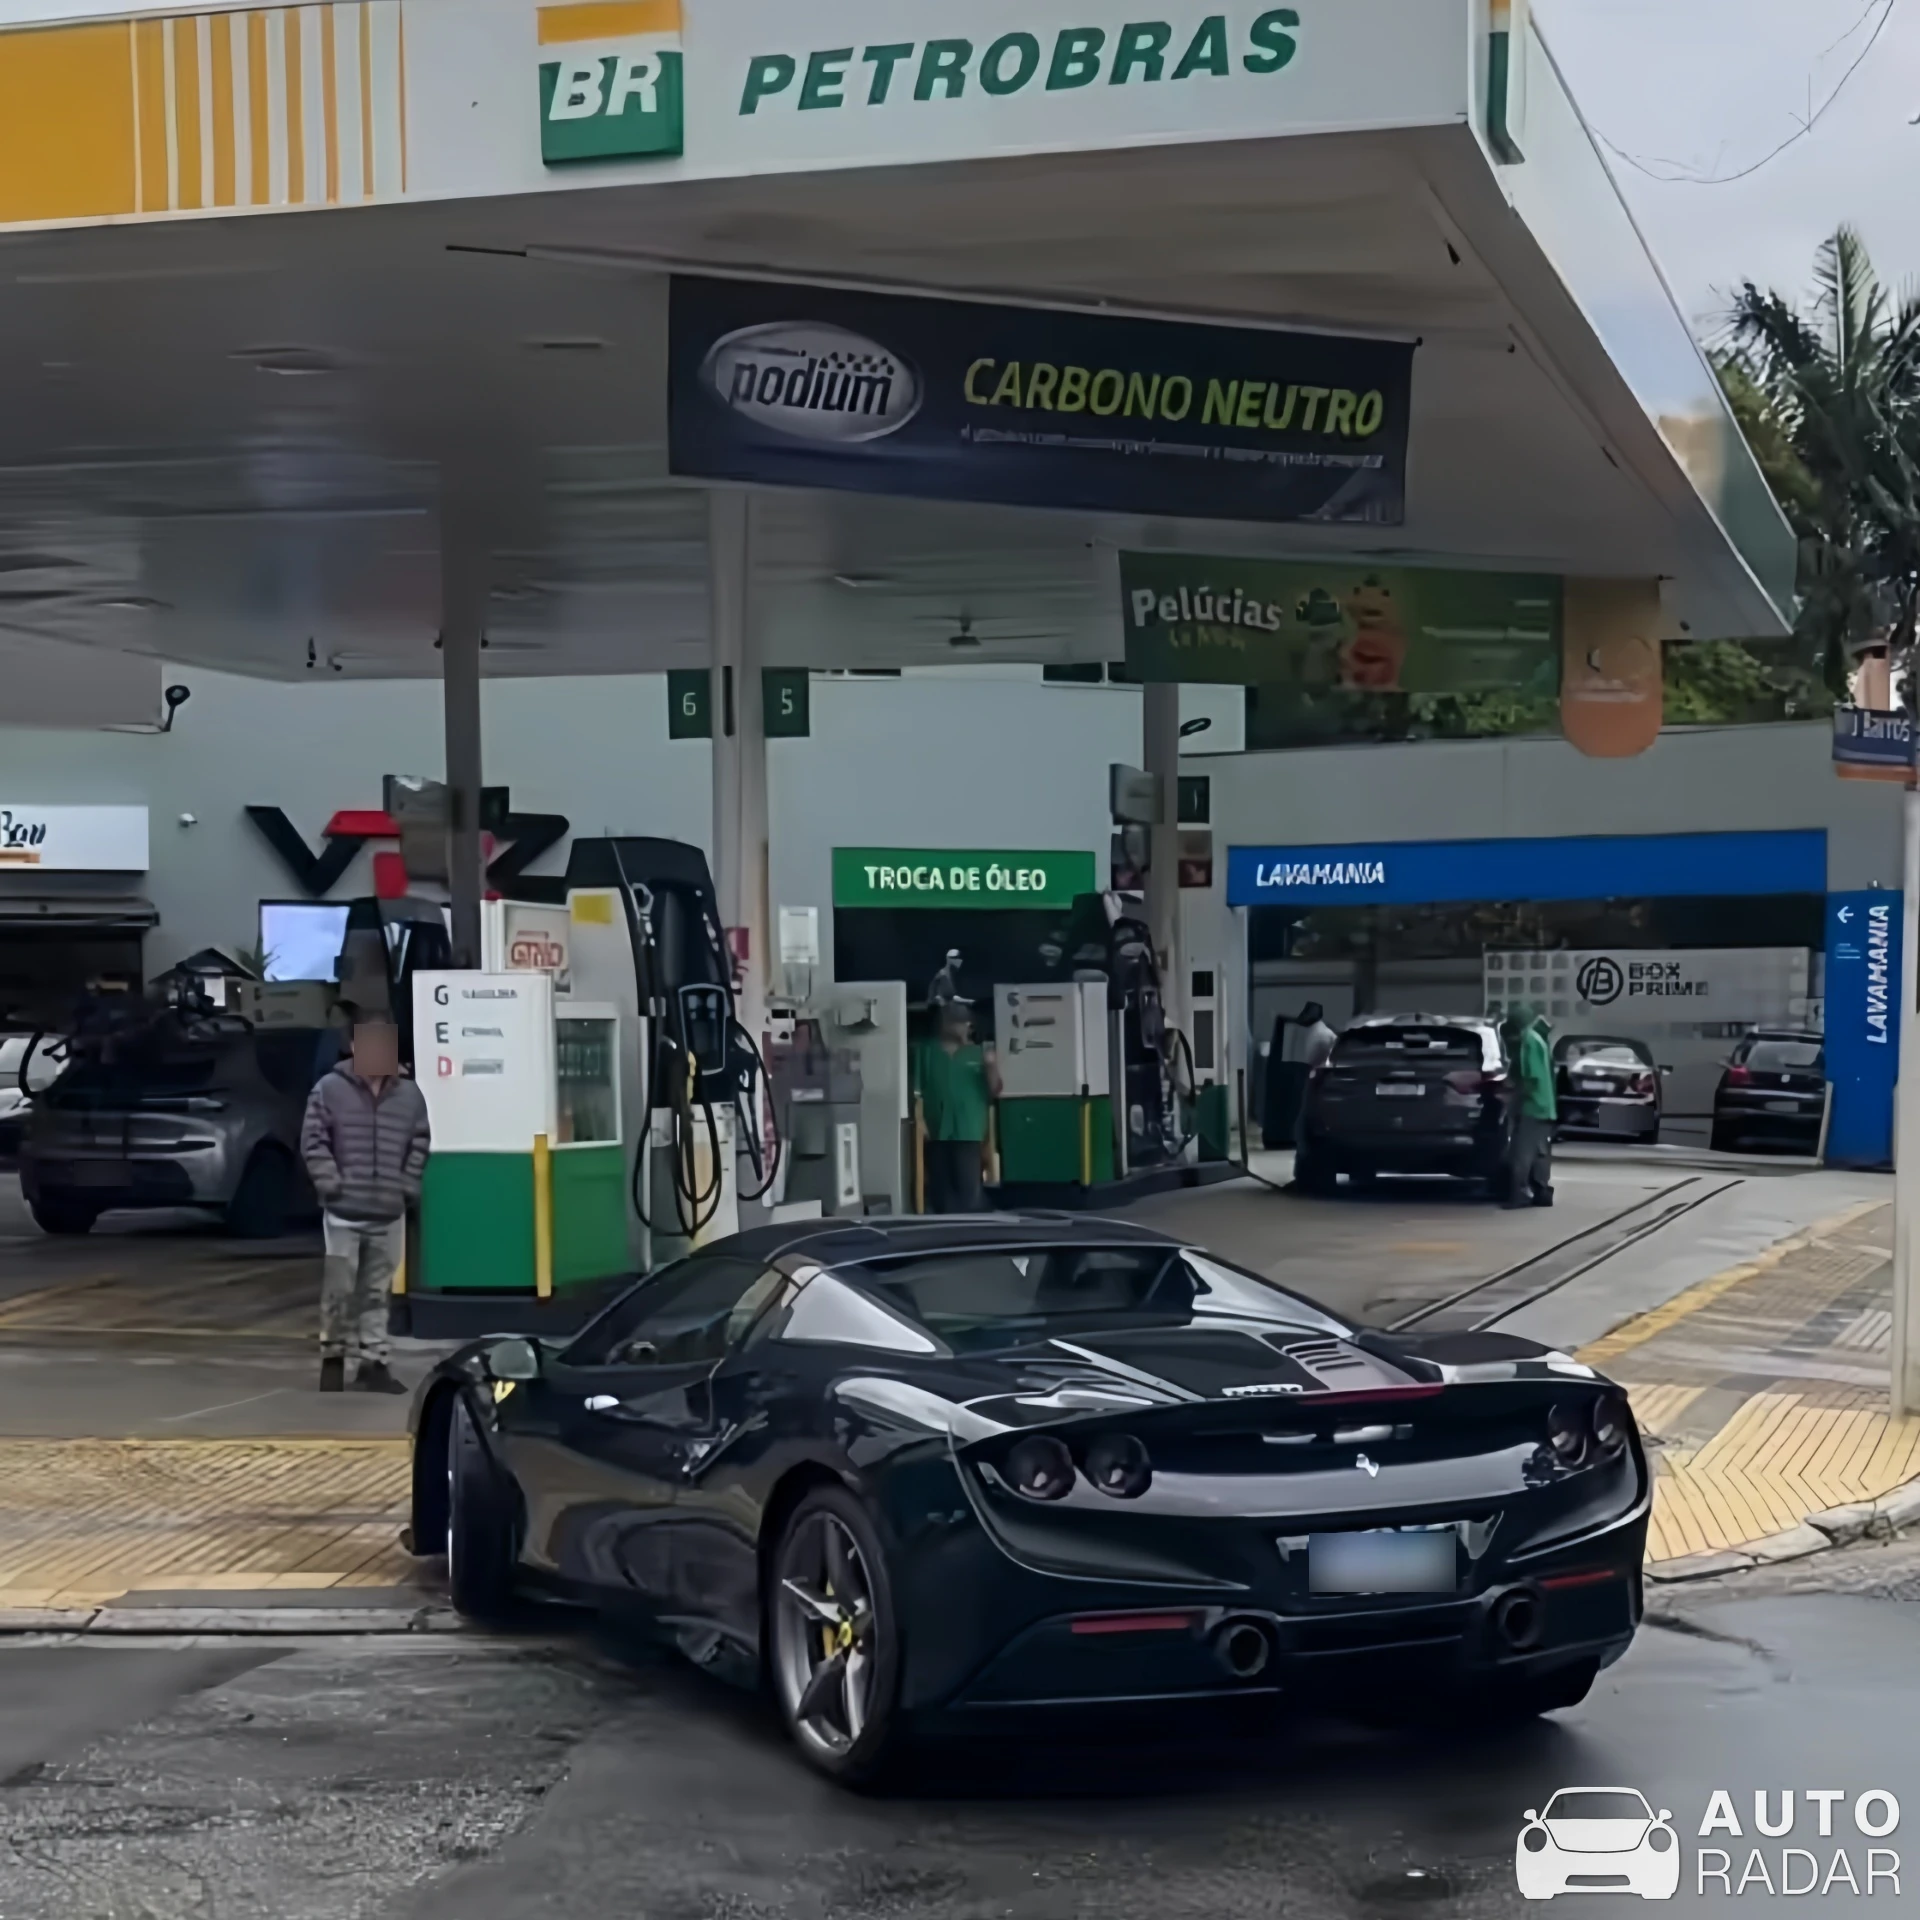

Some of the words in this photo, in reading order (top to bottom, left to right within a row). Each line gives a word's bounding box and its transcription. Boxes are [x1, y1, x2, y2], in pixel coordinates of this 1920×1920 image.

[548, 52, 662, 121] BR
[738, 8, 1301, 116] PETROBRAS
[729, 356, 893, 416] podium
[963, 357, 1193, 421] CARBONO
[1201, 378, 1384, 436] NEUTRO
[1131, 586, 1283, 631] Pelúcias
[682, 691, 697, 716] 6
[781, 687, 794, 715] 5
[864, 865, 945, 890] TROCA
[949, 866, 981, 891] DE
[985, 863, 1047, 891] ÓLEO
[1628, 962, 1681, 980] BOX
[434, 985, 450, 1006] G
[435, 1021, 450, 1044] E
[437, 1055, 453, 1077] D
